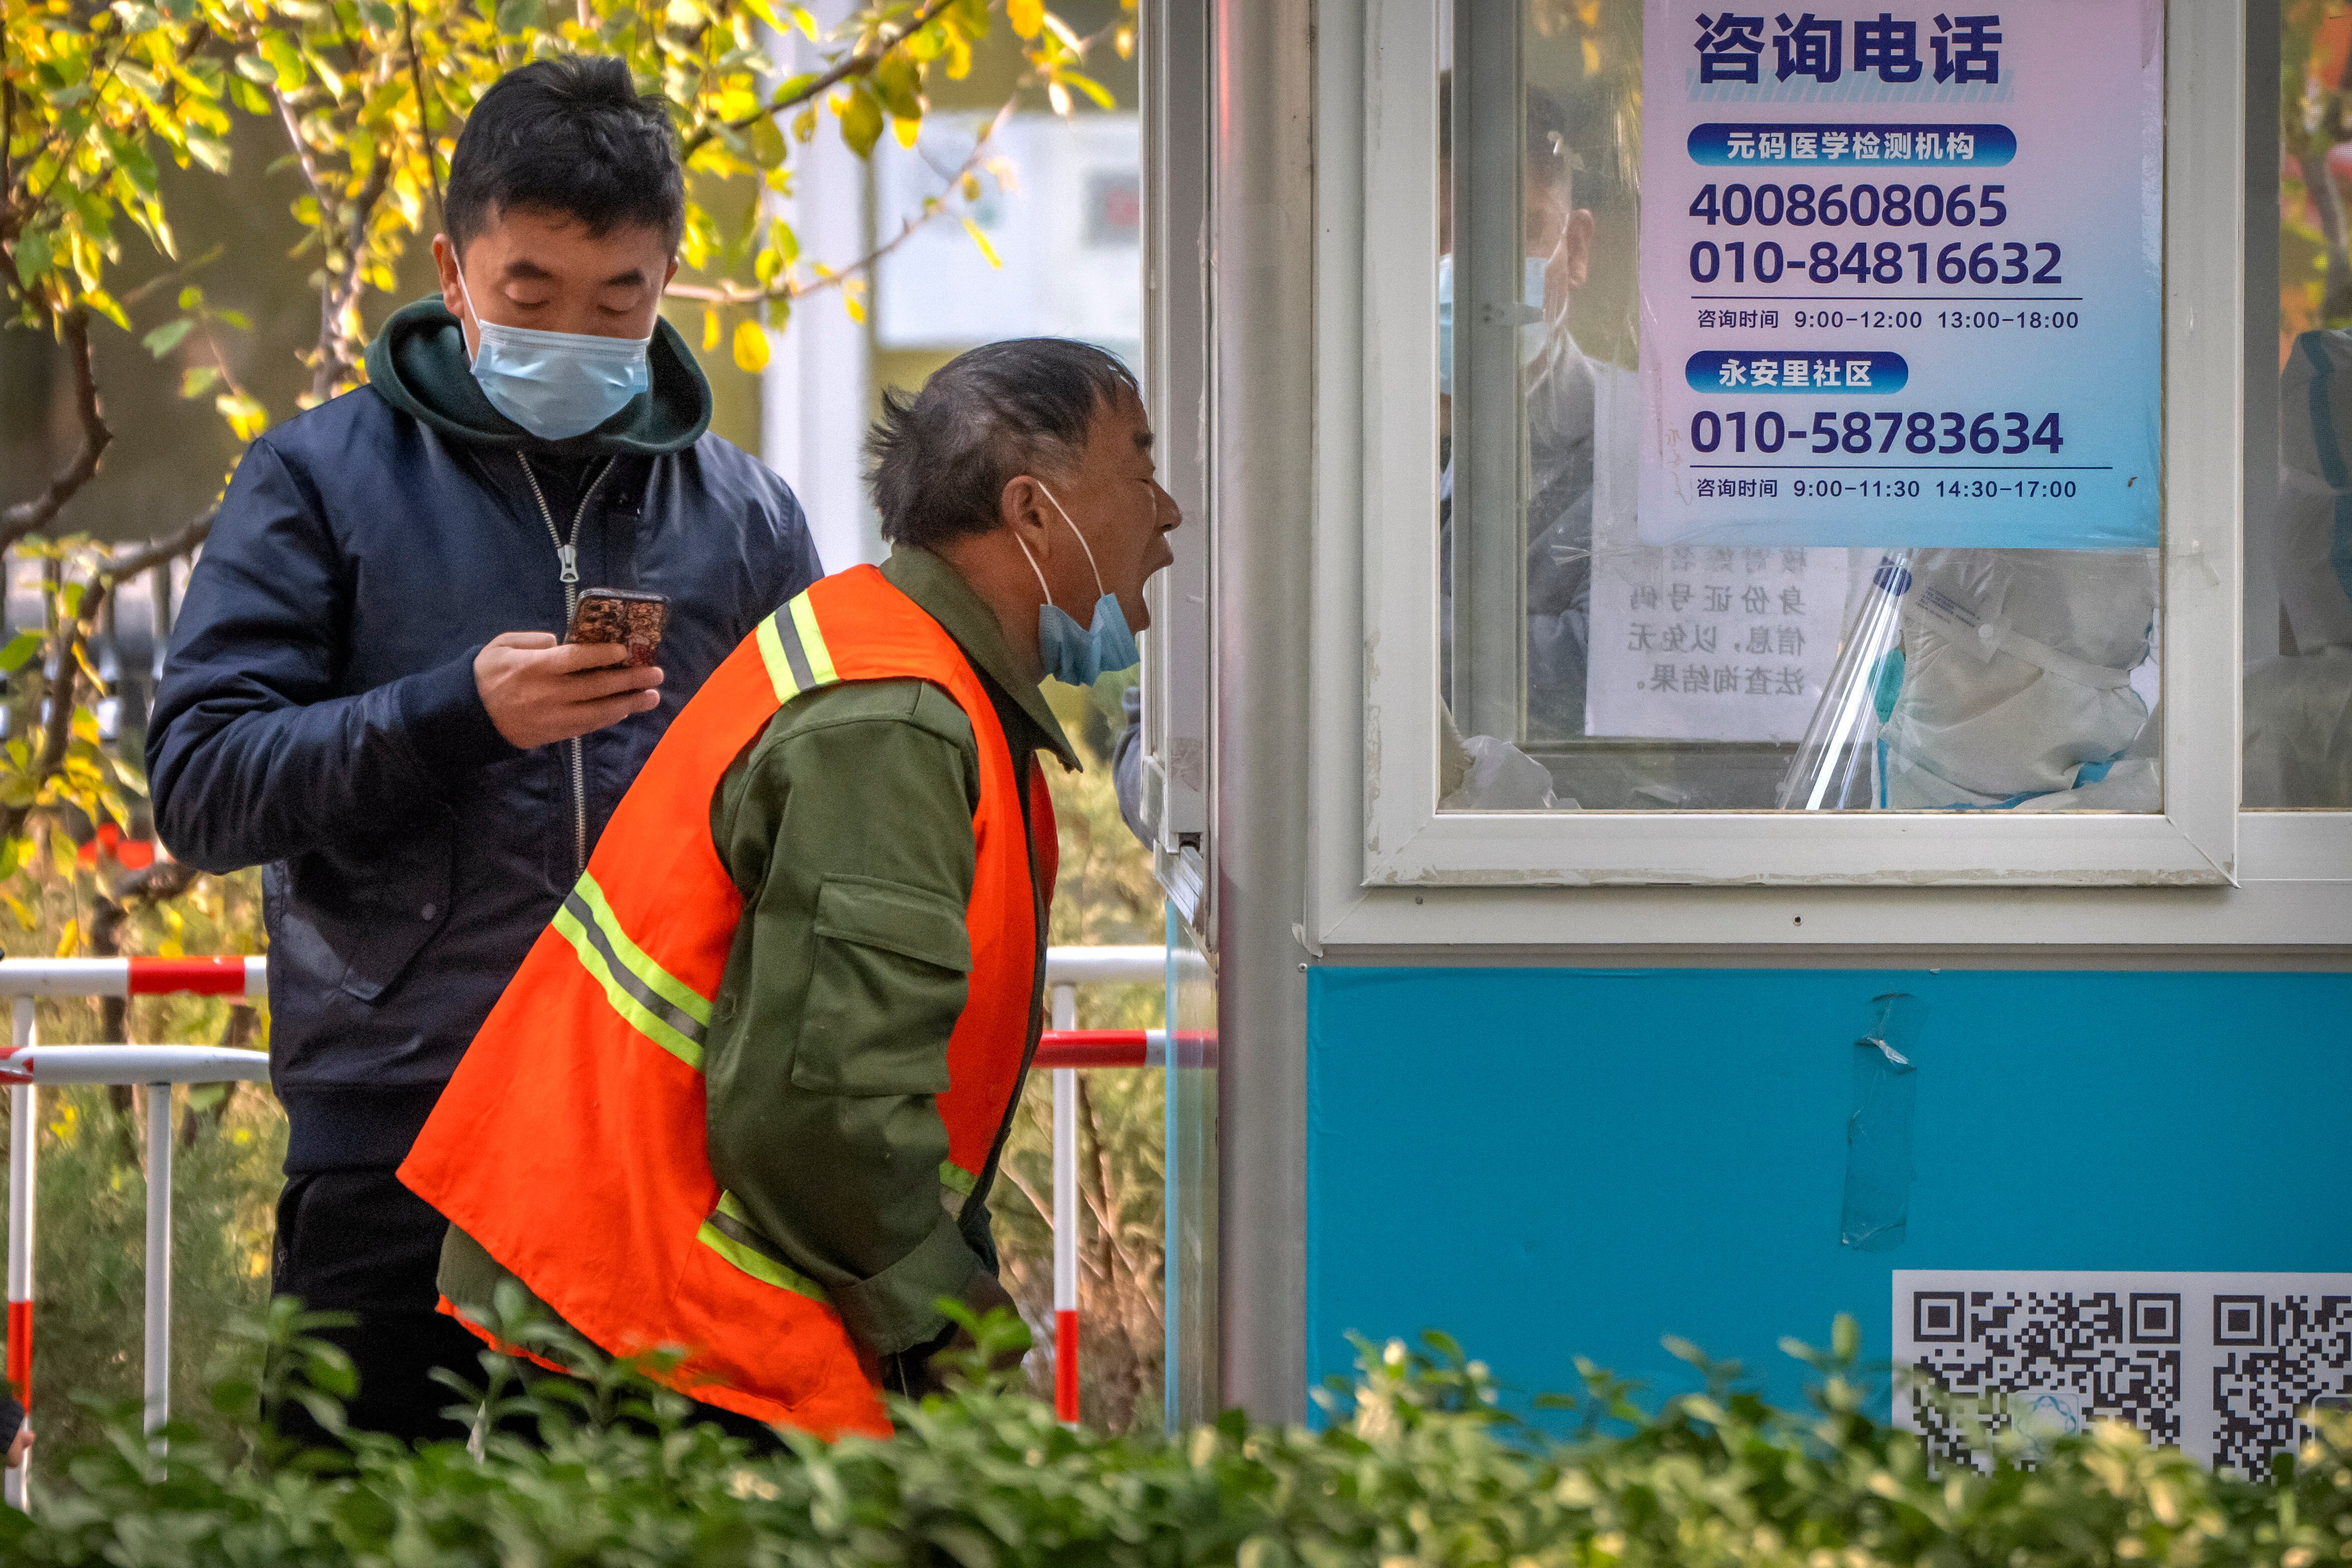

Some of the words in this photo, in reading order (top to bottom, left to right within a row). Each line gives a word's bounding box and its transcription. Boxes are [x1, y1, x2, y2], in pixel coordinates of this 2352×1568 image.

[1694, 13, 2003, 85] 咨询电话
[1727, 132, 1975, 160] 元码医学检测机构
[1689, 183, 2007, 227] 4008608065
[1689, 241, 2062, 284] 010-84816632
[1697, 309, 1779, 329] 咨询时间
[1794, 311, 1923, 329] 9:00-12:00
[1938, 311, 2079, 329] 13:00-18:00
[1719, 359, 1872, 387] 永安里社区
[1690, 410, 2064, 454] 010-58783634
[1696, 478, 1778, 498] 咨询时间
[1793, 480, 1920, 498] 9:00-11:30
[1936, 480, 2077, 498] 14:30-17:00
